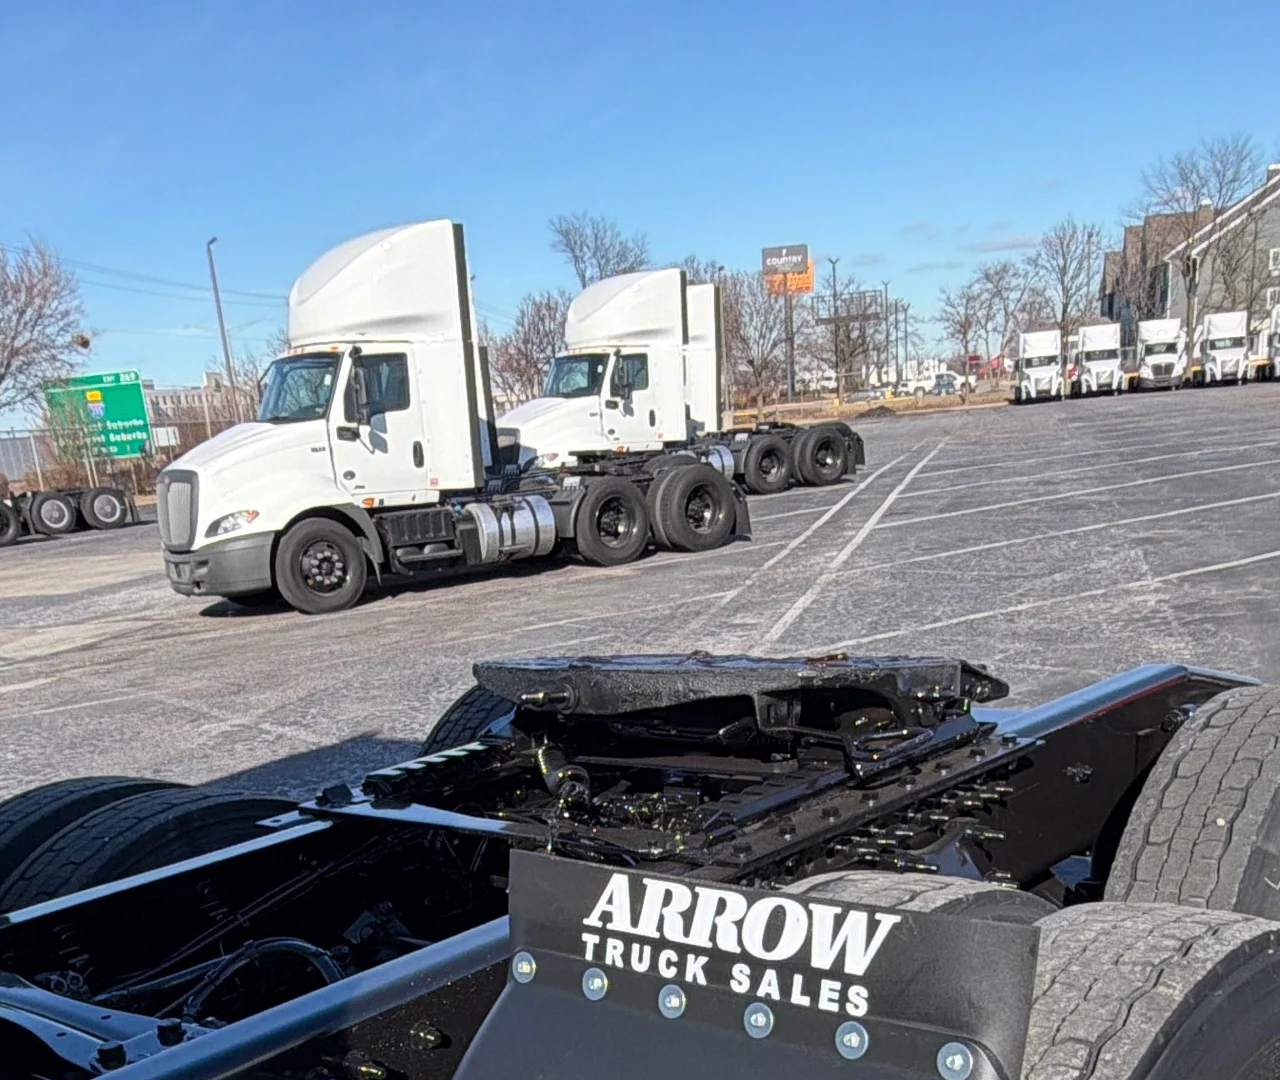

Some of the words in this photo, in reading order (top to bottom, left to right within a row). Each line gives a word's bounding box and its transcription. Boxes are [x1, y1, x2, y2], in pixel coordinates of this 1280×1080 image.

[766, 255, 803, 266] COUNTRY
[119, 372, 136, 381] 269
[109, 431, 148, 442] Suburbs
[583, 873, 901, 977] ARROW
[582, 933, 709, 985] TRUCK
[729, 963, 869, 1018] SALES
